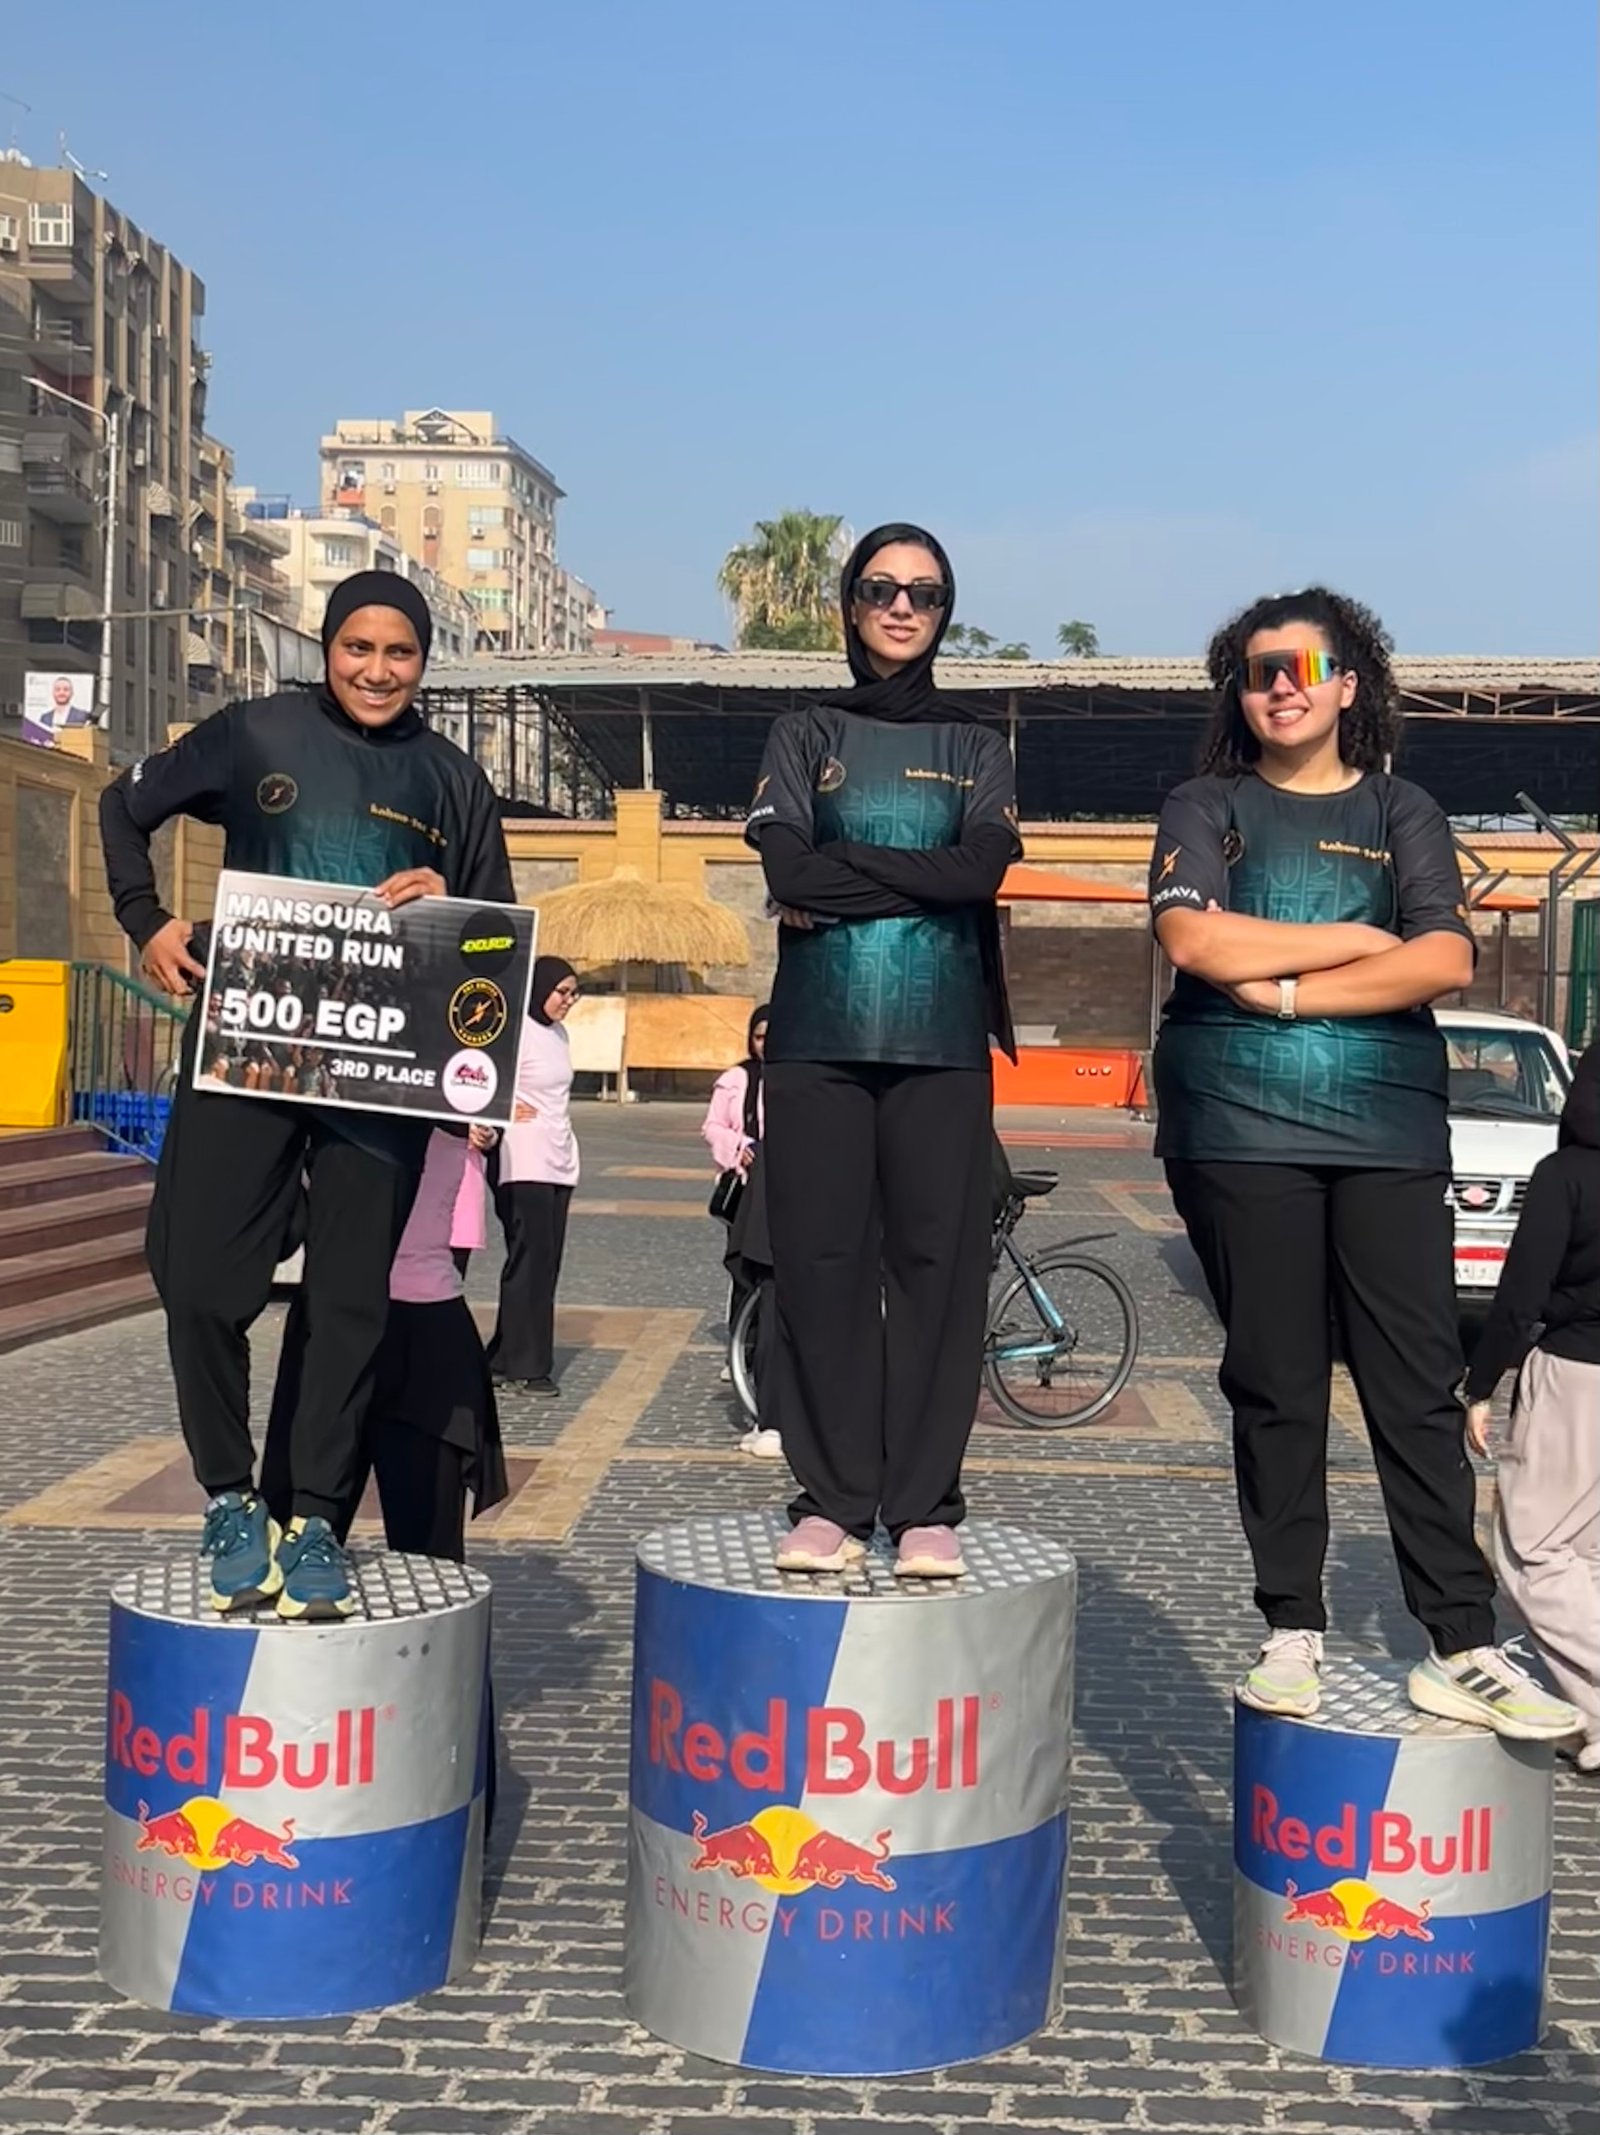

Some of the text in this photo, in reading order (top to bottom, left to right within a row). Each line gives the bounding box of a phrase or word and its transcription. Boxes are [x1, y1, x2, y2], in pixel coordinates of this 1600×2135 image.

[227, 894, 393, 935] MANSOURA
[223, 926, 404, 970] UNITED RUN
[221, 988, 405, 1043] 500 EGP
[330, 1059, 370, 1079] 3RD
[374, 1064, 436, 1088] PLACE
[111, 1690, 376, 1789] Red Bull
[647, 1677, 981, 1795] Red Bull
[1251, 1783, 1492, 1875] Red Bull
[113, 1857, 354, 1910] ENERGY DRINK
[654, 1875, 956, 1941] ENERGY DRINK
[1257, 1925, 1475, 1976] ENERGY DRINK
